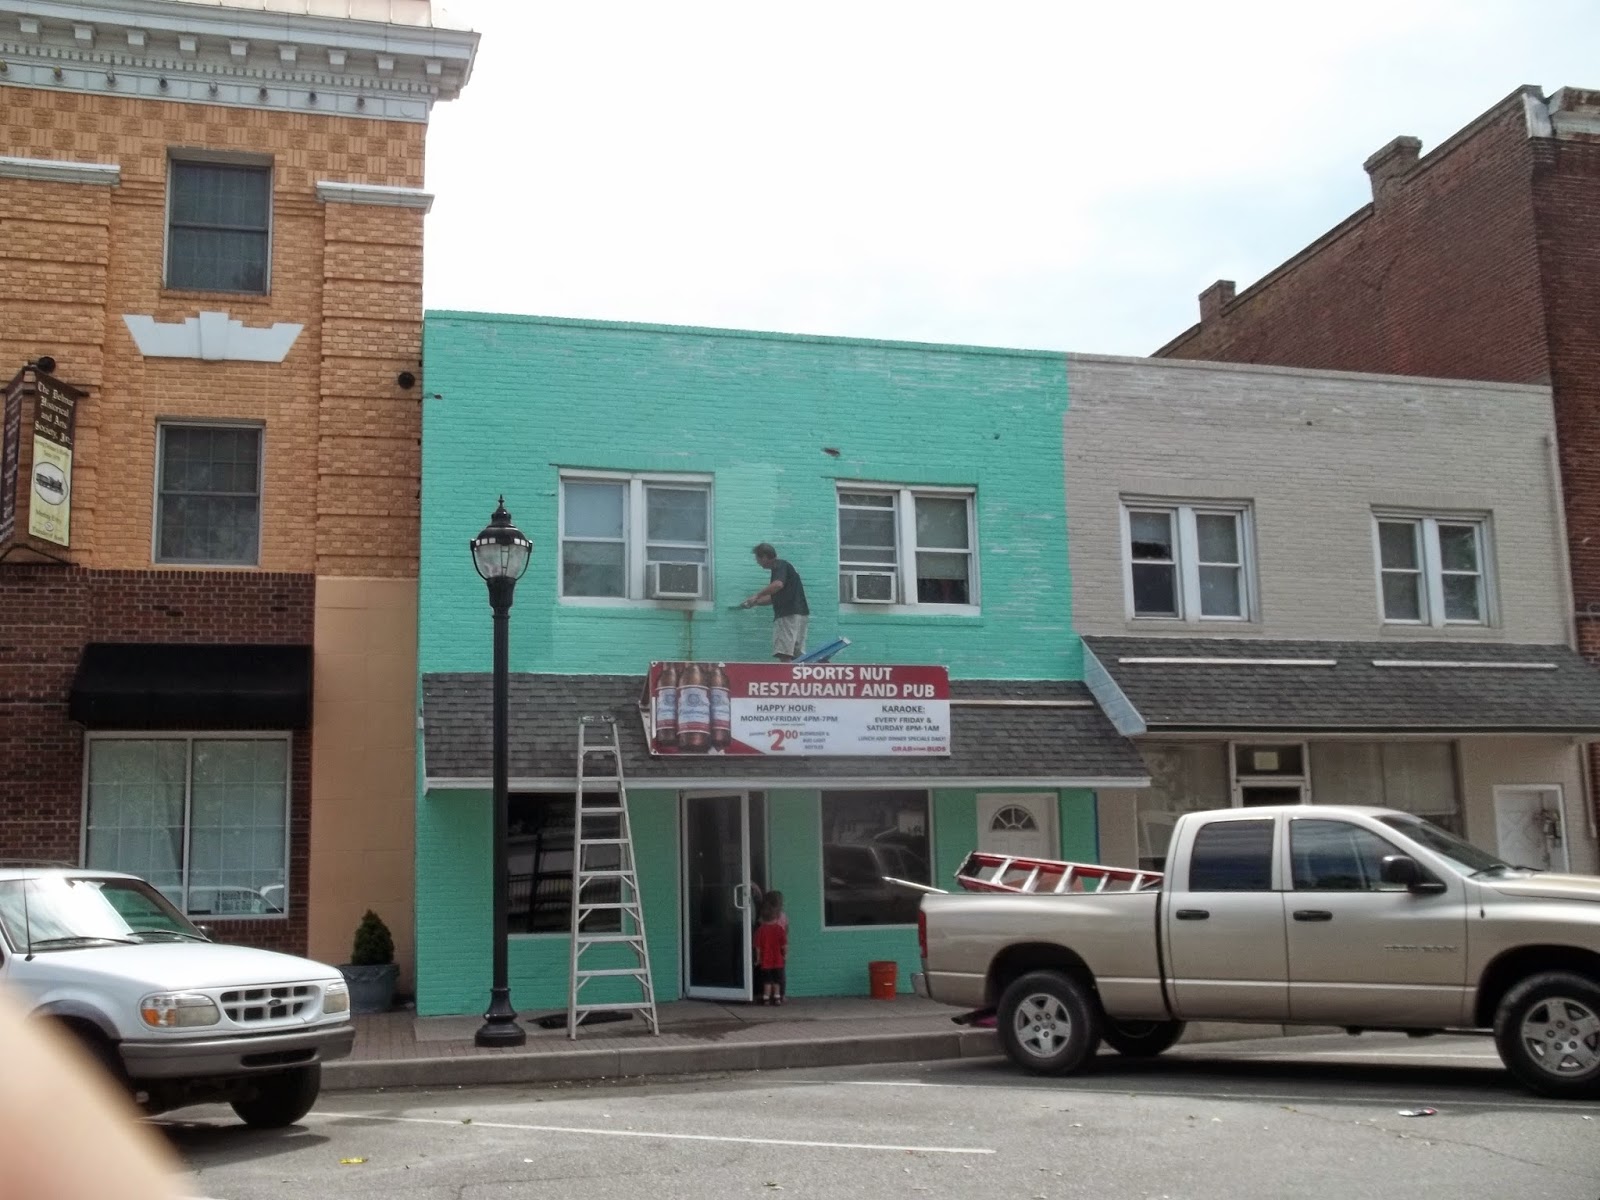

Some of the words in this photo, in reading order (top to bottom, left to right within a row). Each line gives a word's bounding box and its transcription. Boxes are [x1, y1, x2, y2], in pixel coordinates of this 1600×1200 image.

[40, 412, 53, 423] and
[792, 666, 855, 680] SPORTS
[859, 667, 893, 681] NUT
[748, 682, 857, 697] RESTAURANT
[860, 683, 898, 698] AND
[903, 684, 935, 698] PUB
[756, 704, 786, 713] HAPPY
[788, 704, 817, 713] HOUR:
[881, 705, 926, 714] KARAOKE:
[740, 715, 801, 723] MONDAY-FRIDAY
[803, 715, 839, 723] 4PM-7PM
